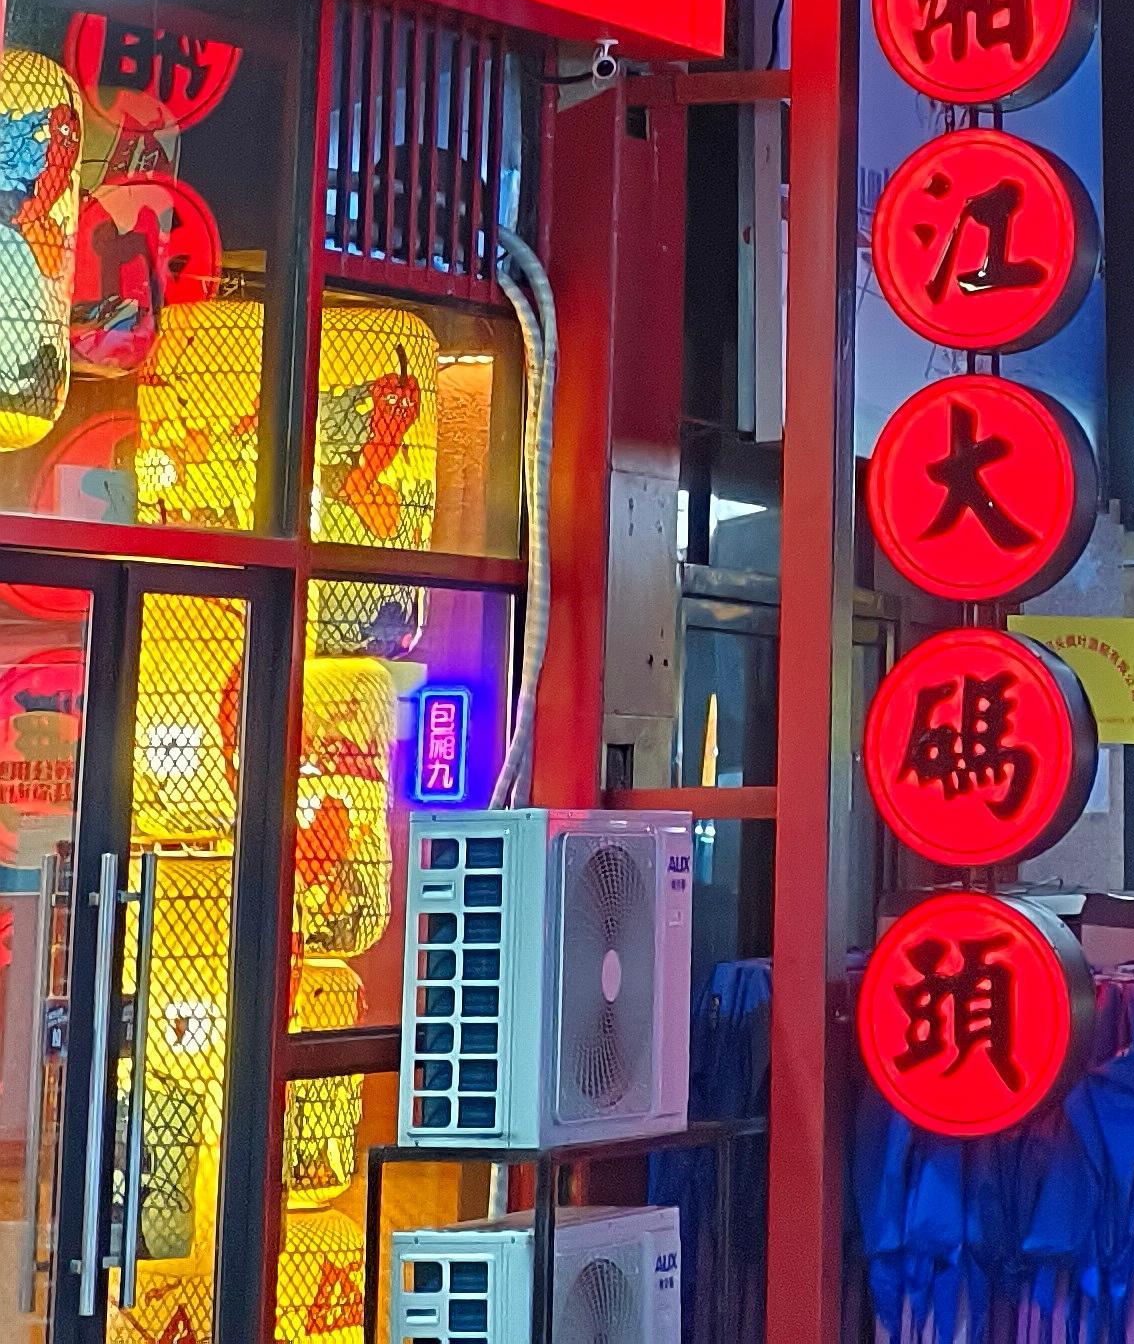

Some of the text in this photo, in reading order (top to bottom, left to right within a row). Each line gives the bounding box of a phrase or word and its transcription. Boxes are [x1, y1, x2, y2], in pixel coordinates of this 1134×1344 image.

[426, 701, 456, 789] 包厢九
[667, 855, 690, 873] AUX
[655, 1252, 678, 1273] AUX
